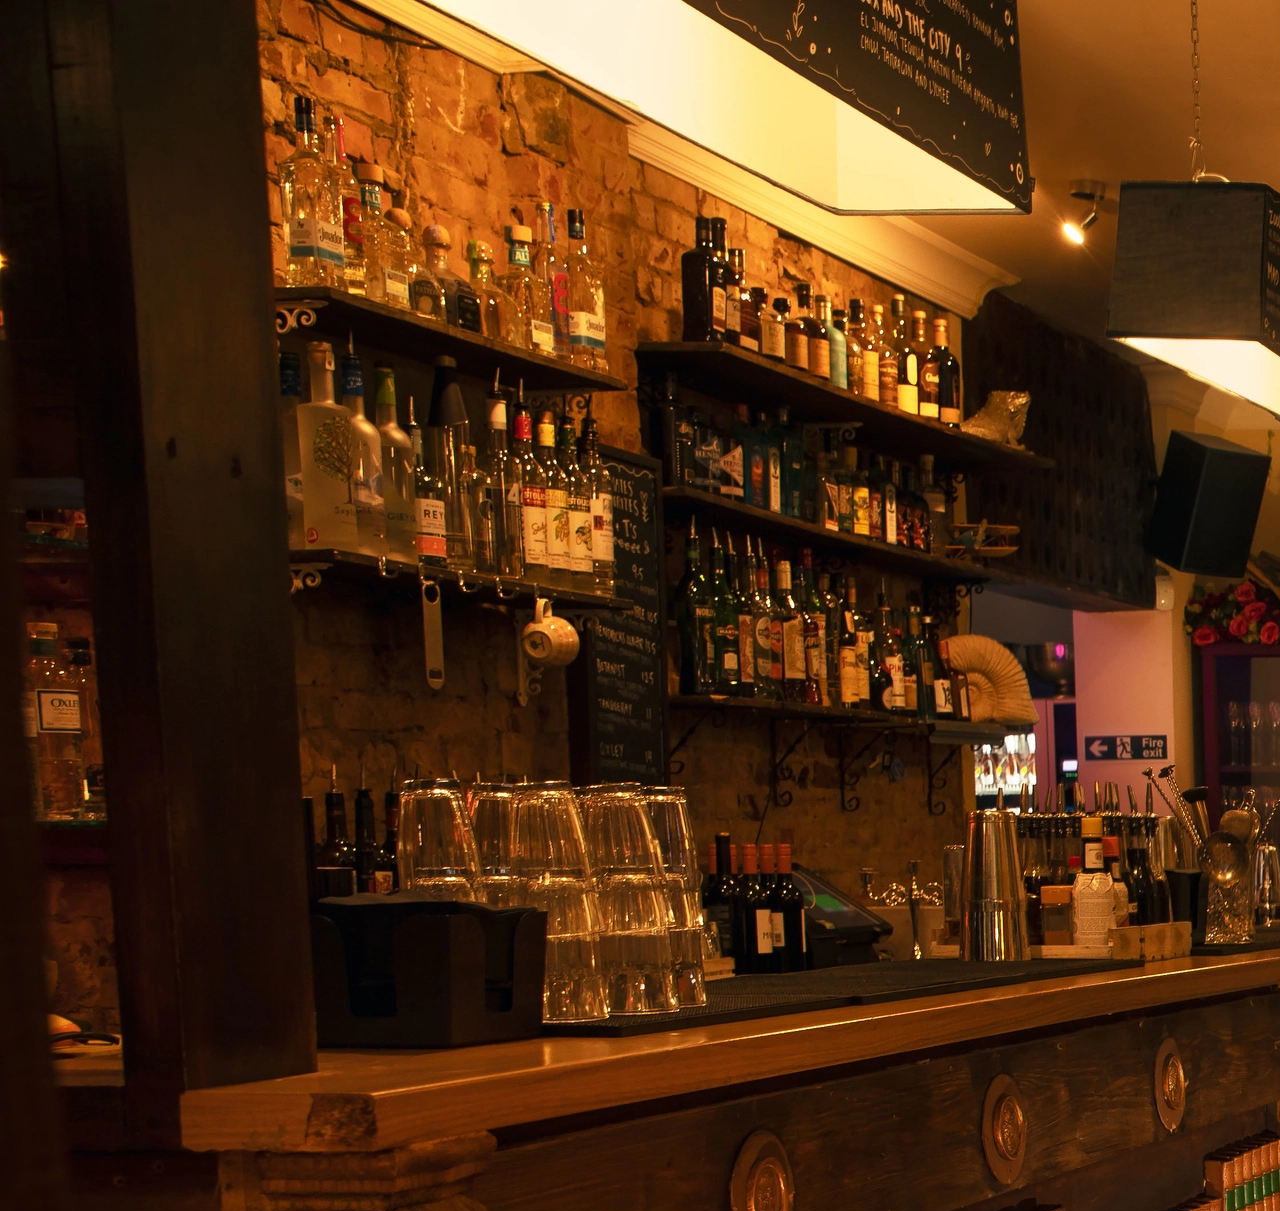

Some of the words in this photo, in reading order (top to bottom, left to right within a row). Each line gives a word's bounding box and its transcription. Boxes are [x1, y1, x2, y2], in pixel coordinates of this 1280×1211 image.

[861, 11, 869, 28] EL
[905, 8, 927, 44] THE
[929, 27, 950, 59] CITY
[1142, 738, 1163, 748] Fire
[1142, 749, 1163, 758] exit
